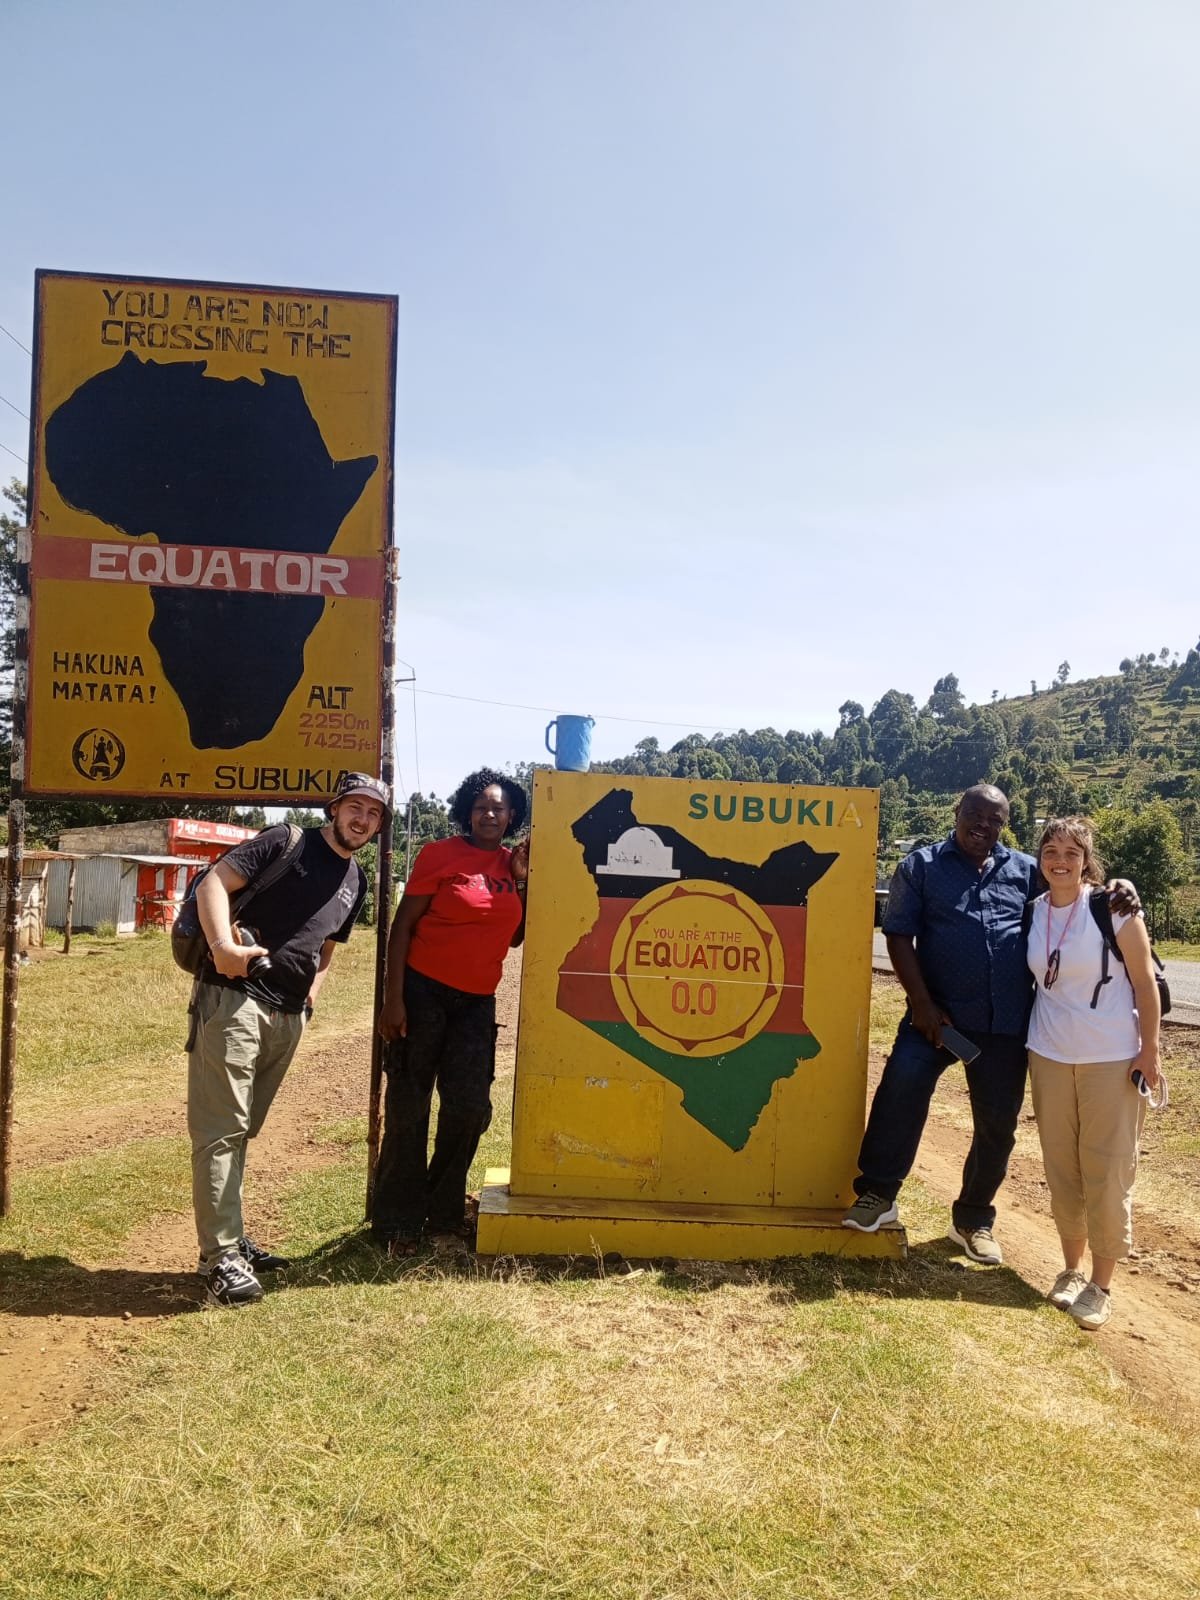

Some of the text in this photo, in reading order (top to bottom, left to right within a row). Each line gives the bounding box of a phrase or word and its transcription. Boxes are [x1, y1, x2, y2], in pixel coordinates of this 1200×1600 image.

[102, 289, 329, 330] YOU ARE NOW
[283, 331, 351, 359] THE
[89, 543, 350, 595] EQUATOR
[53, 651, 144, 677] HAKUNA
[52, 681, 156, 704] MATATA!
[307, 685, 354, 710] ALT
[299, 713, 370, 731] 2250m
[159, 773, 191, 788] AT
[688, 793, 862, 828] SUBUKIA
[653, 928, 742, 943] YOU ARE AT THE
[634, 941, 761, 974] EQUATOR
[671, 981, 717, 1016] 0.0
